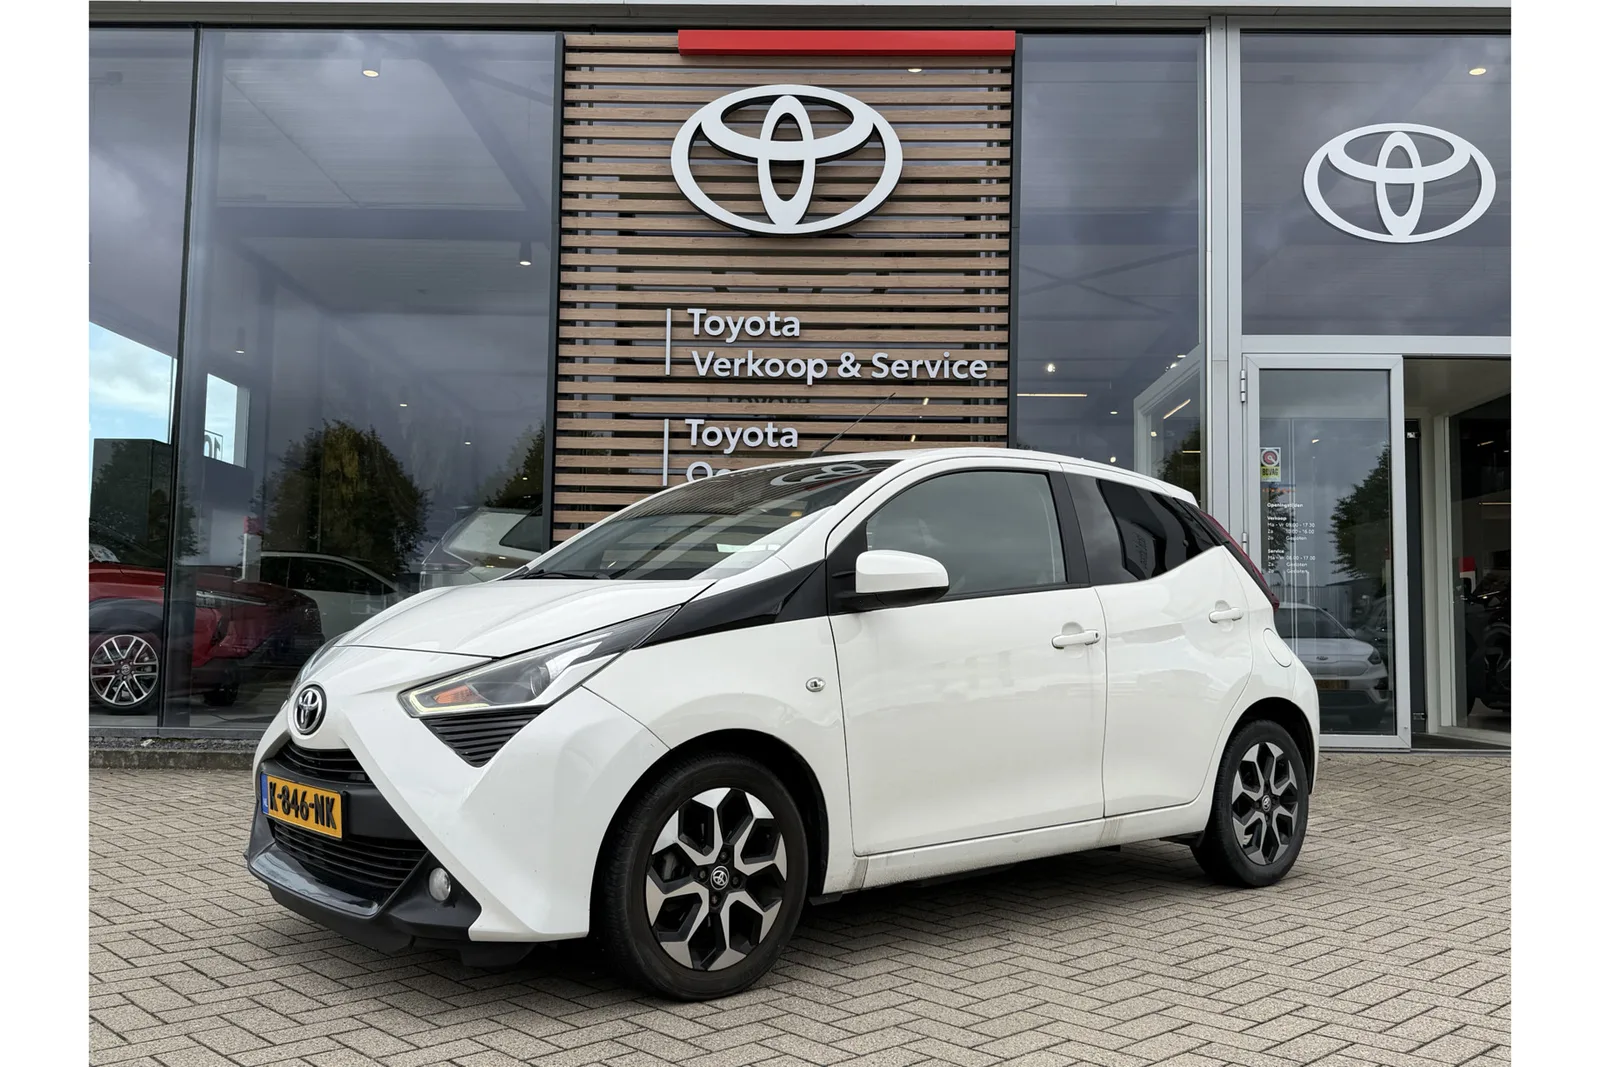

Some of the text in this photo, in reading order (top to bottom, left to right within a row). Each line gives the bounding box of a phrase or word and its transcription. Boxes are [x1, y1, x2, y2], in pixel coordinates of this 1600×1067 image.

[687, 308, 800, 343] Toyota
[691, 350, 988, 386] Verkoop & Service
[685, 418, 798, 454] Toyota
[1262, 468, 1279, 476] BOVAG
[269, 781, 337, 830] K-846-NK
